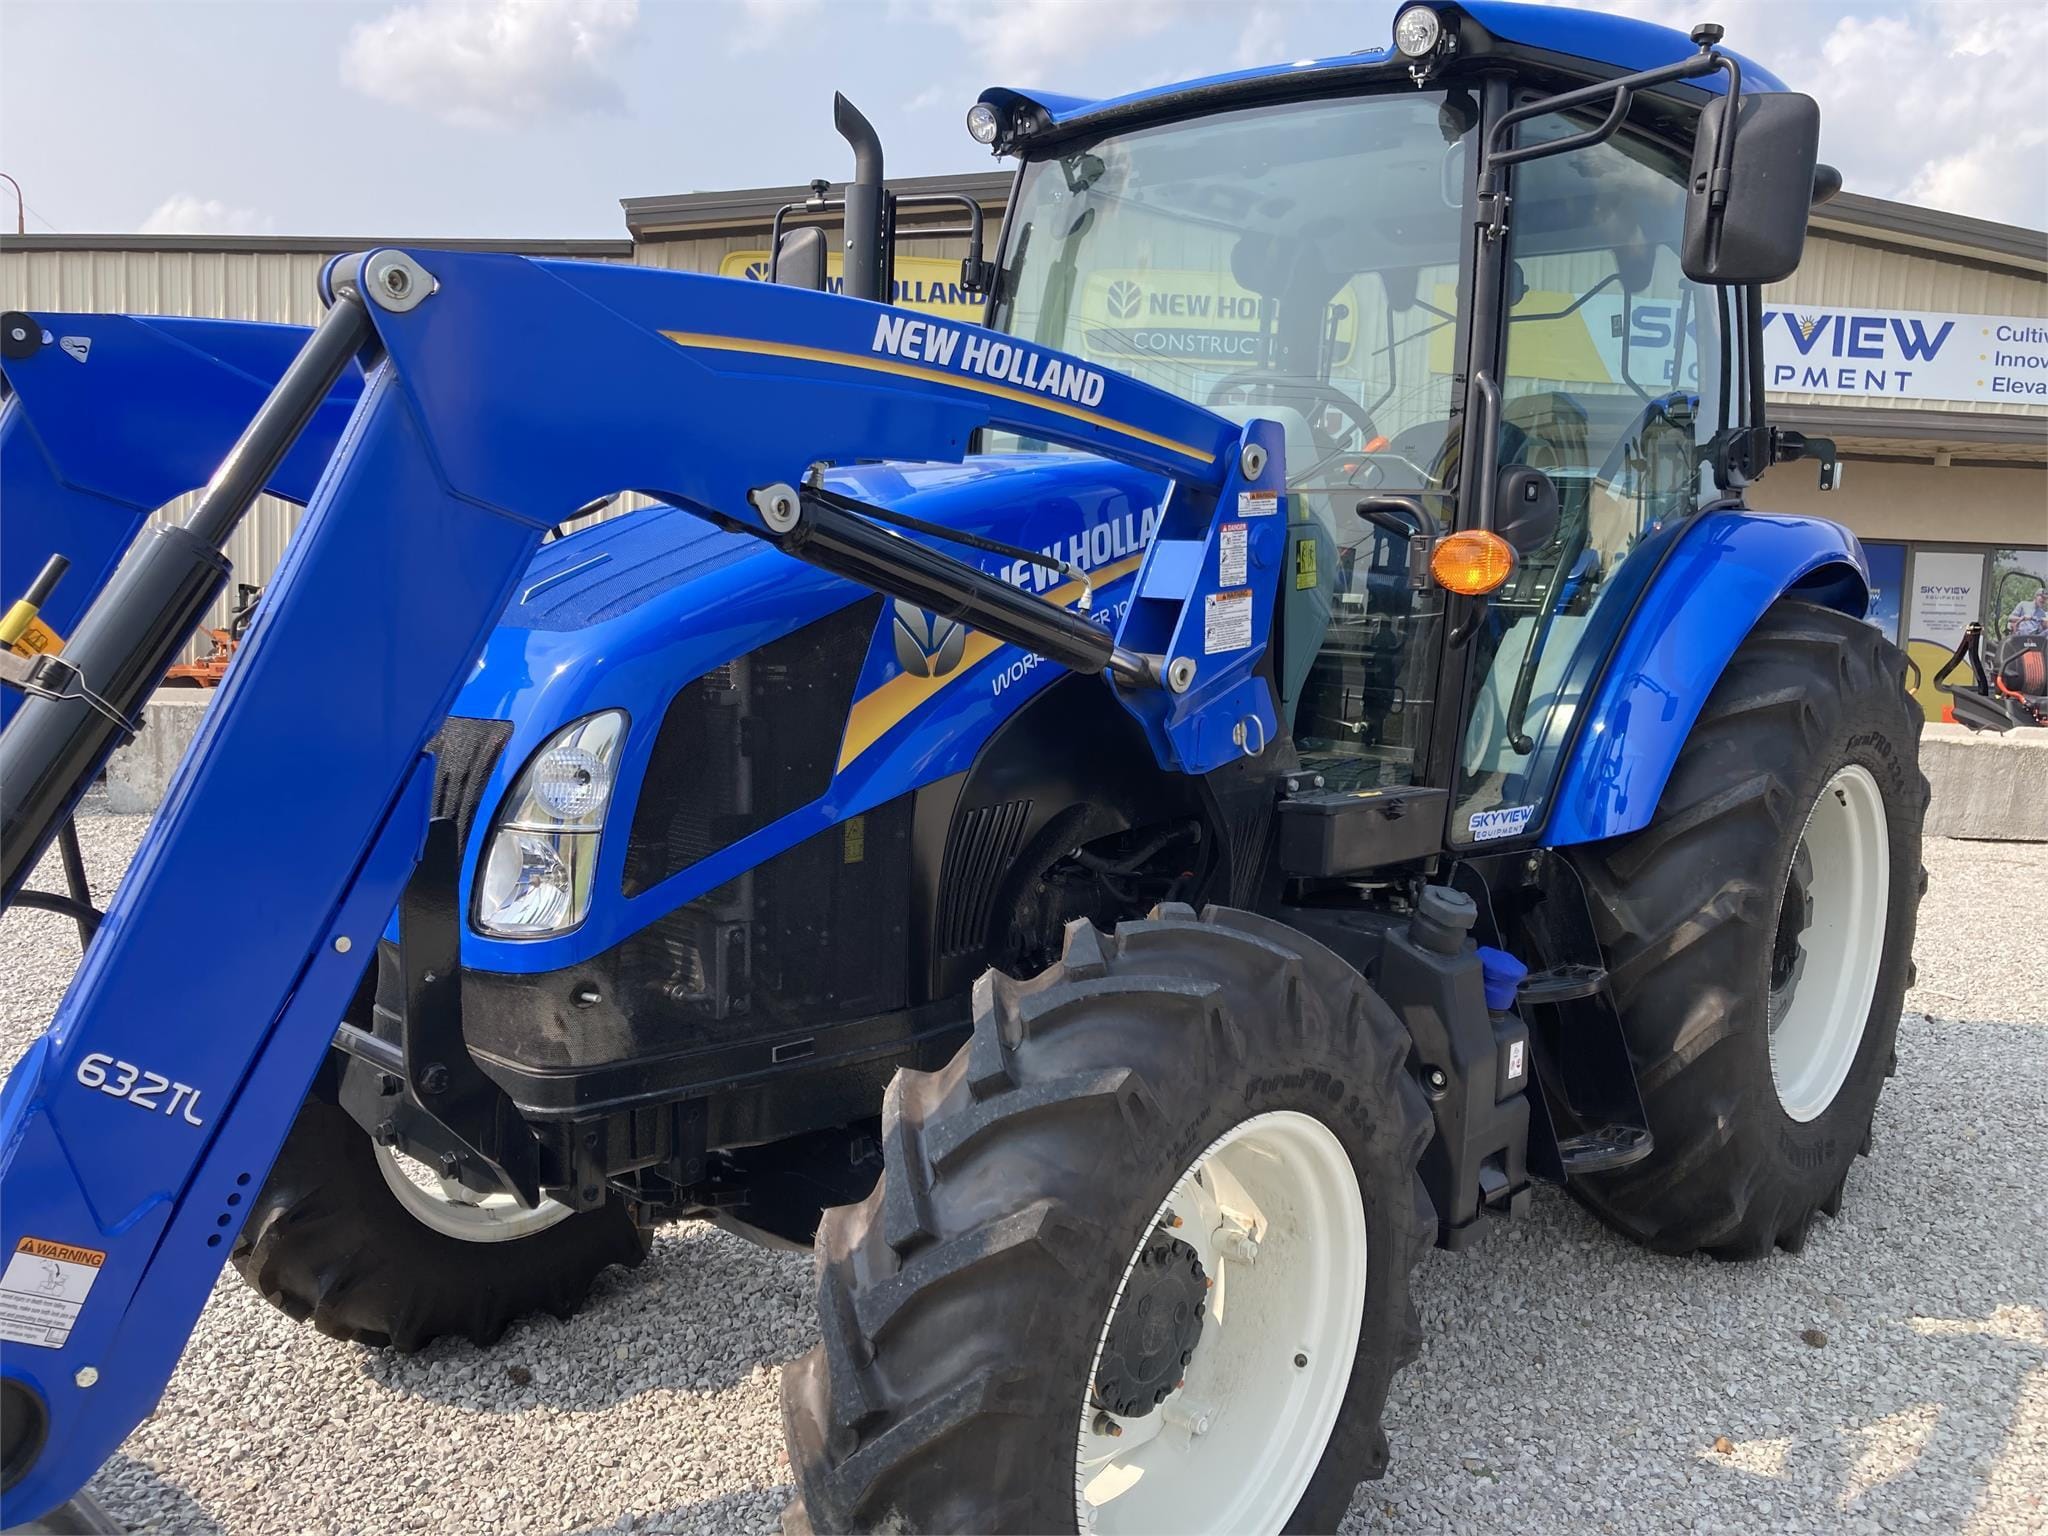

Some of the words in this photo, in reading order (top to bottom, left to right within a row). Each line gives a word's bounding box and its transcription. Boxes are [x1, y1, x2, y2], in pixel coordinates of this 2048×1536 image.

[1150, 293, 1211, 319] NEW
[872, 313, 960, 366] NEW
[961, 334, 1105, 407] HOLLAND
[1992, 376, 2048, 395] Eleva
[1920, 585, 1971, 595] SKYVIEW
[1471, 808, 1532, 829] SKYVIEW
[1475, 824, 1523, 839] EQUIPMENT
[77, 1053, 203, 1126] 632TL
[36, 1242, 103, 1266] WARNING
